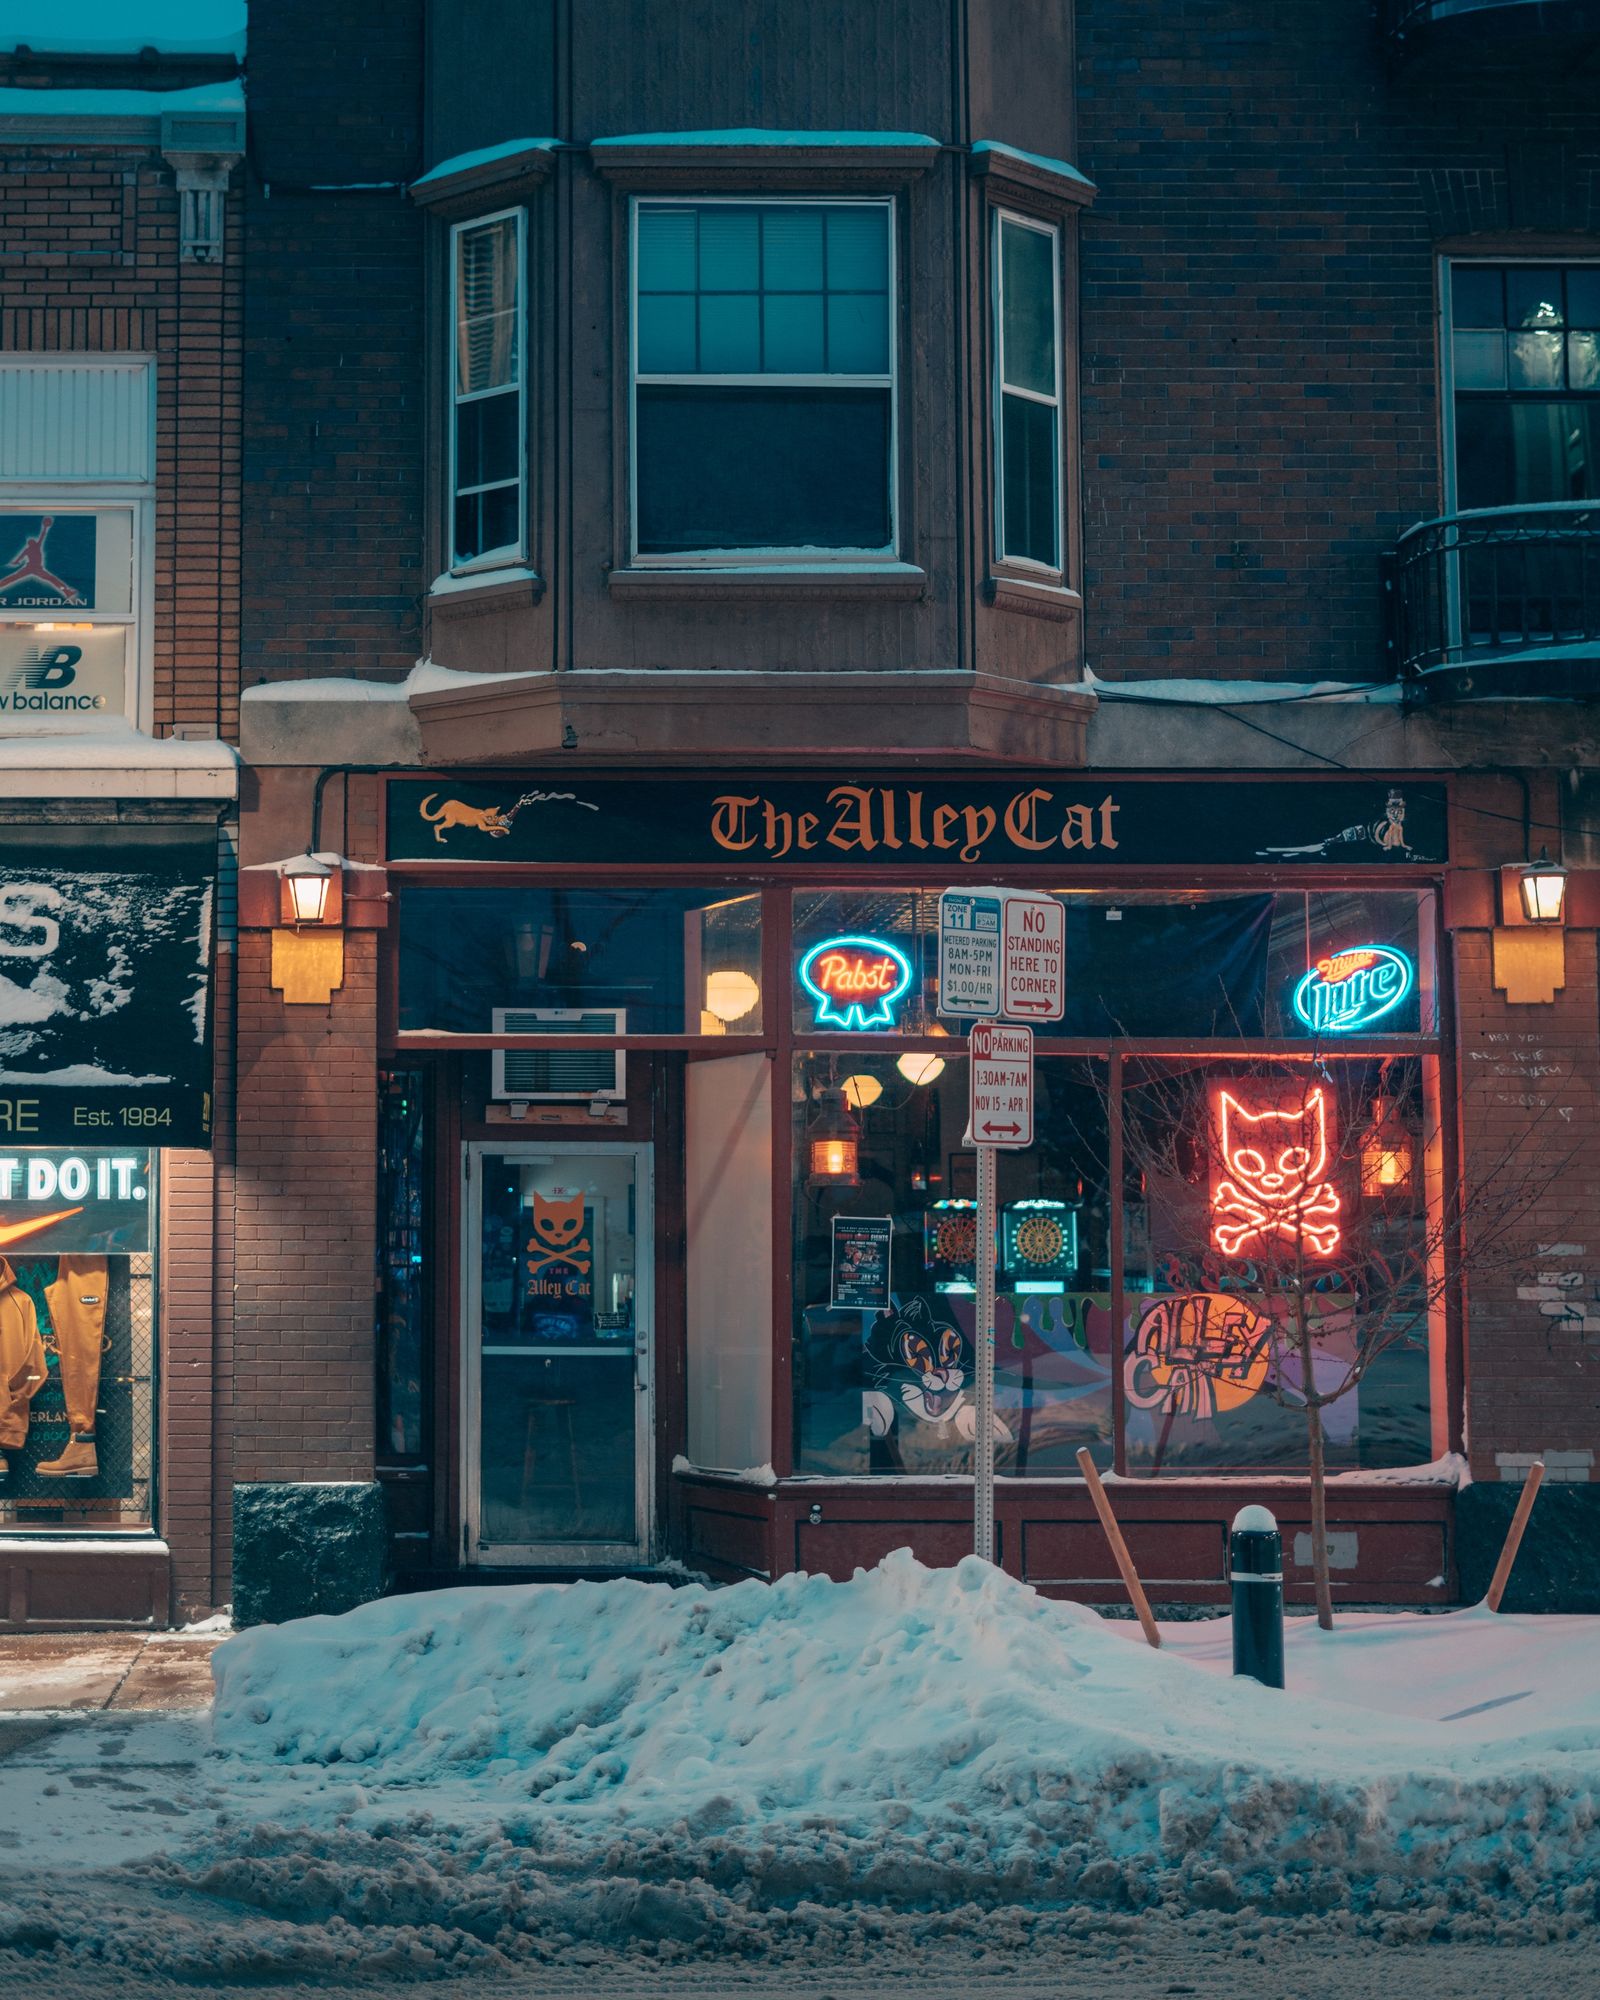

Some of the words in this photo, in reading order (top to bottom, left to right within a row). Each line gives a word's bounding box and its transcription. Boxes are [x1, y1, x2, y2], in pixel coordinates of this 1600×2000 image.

[12, 597, 88, 606] JORDAN
[13, 691, 105, 711] balance
[710, 795, 820, 858] The
[825, 786, 997, 863] Alley
[1003, 788, 1121, 850] Cat
[947, 904, 968, 914] ZONE
[950, 912, 964, 928] 11
[1023, 911, 1046, 933] NO
[944, 935, 970, 946] METERED
[971, 938, 997, 949] PARKING
[1007, 935, 1060, 954] STANDING
[948, 947, 993, 962] 8AM-5PM
[820, 955, 896, 990] Pabst
[949, 963, 991, 977] MON-FRI
[1010, 957, 1040, 973] HERE
[1044, 958, 1058, 974] TO
[1316, 952, 1376, 981] Miller
[947, 980, 993, 995] $1.00/HR
[1011, 976, 1057, 994] CORNER
[1311, 962, 1397, 1029] Lite
[974, 1031, 991, 1054] NO
[992, 1036, 1028, 1053] PARKING
[976, 1070, 1028, 1087] 1:30AM-7AM
[975, 1095, 990, 1111] NOV
[992, 1096, 1000, 1111] 15
[1008, 1097, 1023, 1112] APR
[73, 1106, 115, 1126] Est.
[119, 1106, 172, 1126] 1984
[27, 1156, 91, 1200] DO
[97, 1157, 146, 1201] IT.
[549, 1267, 569, 1275] THE
[527, 1279, 562, 1299] Alley
[565, 1279, 592, 1296] Cat
[1137, 1295, 1273, 1380] ALLEY
[1123, 1350, 1217, 1421] CAT
